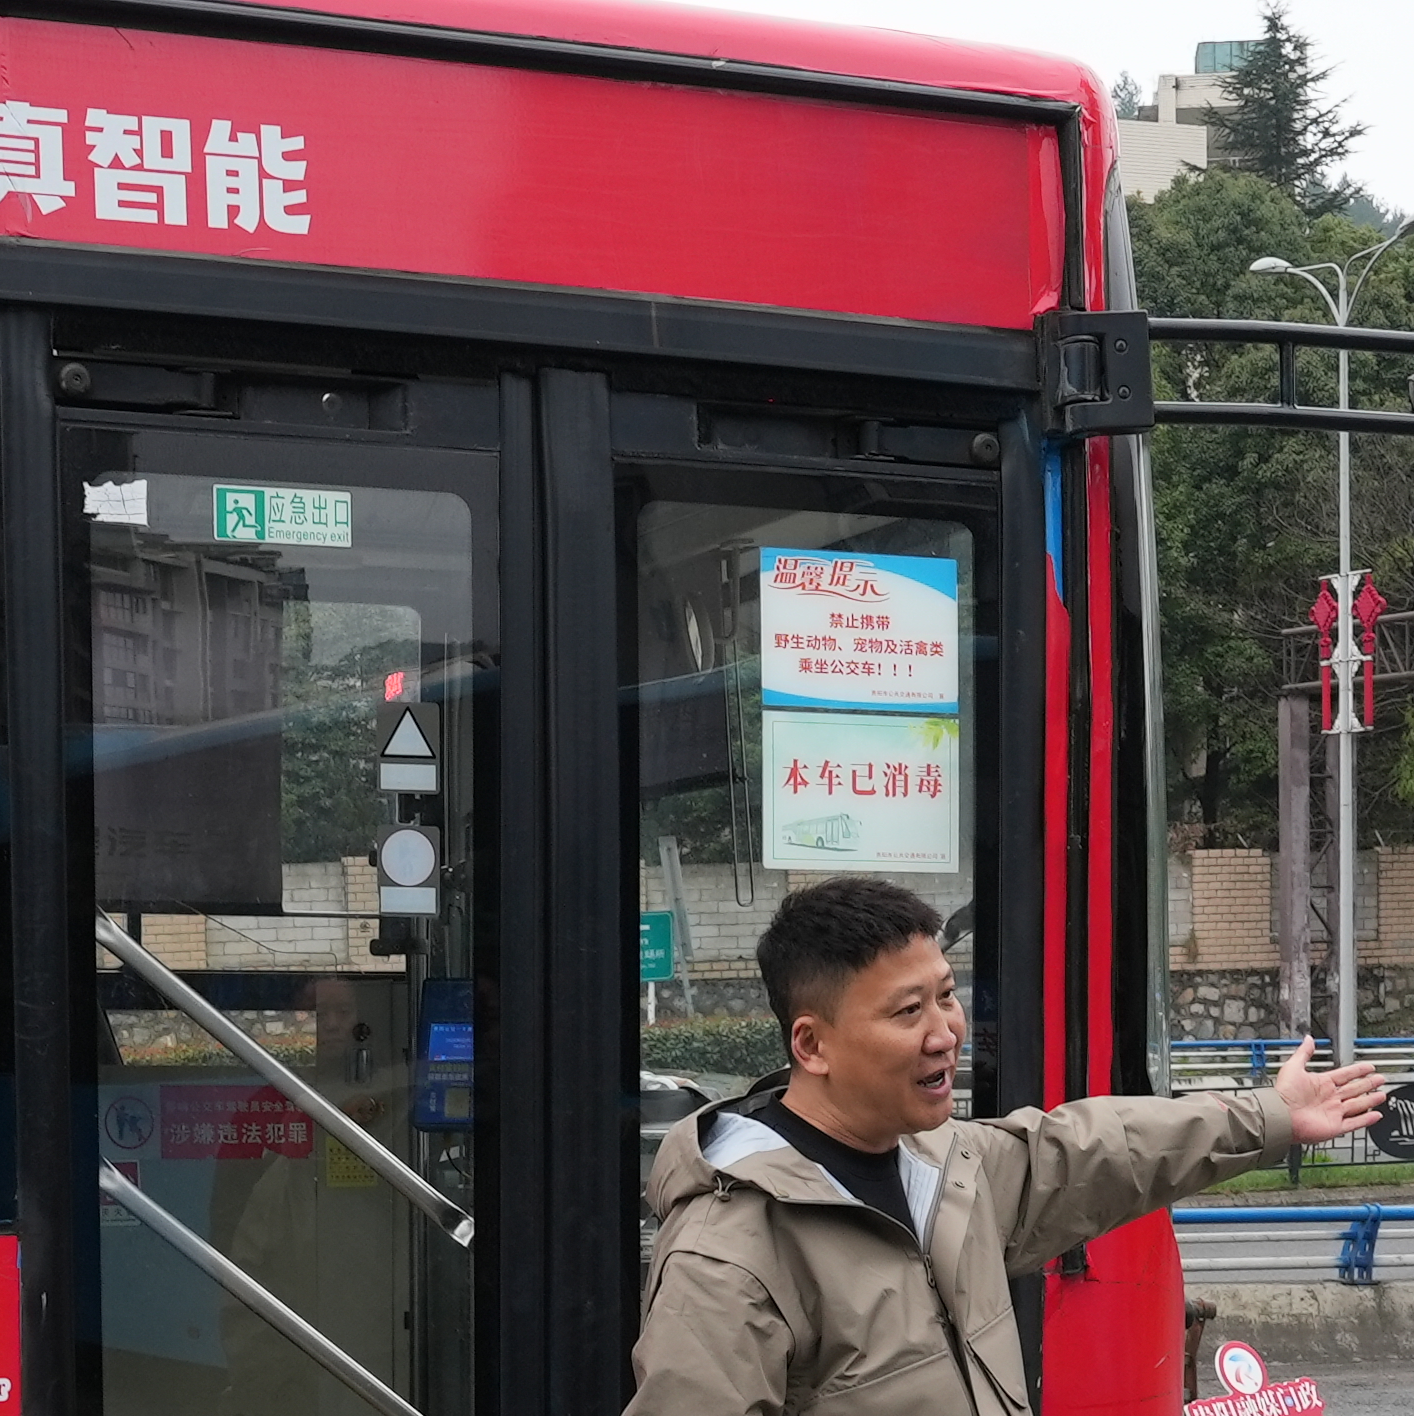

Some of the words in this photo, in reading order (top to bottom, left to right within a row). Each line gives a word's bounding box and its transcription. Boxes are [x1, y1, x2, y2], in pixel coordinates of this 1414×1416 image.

[268, 491, 349, 528] 应急出口
[268, 527, 328, 544] Emergency
[330, 531, 350, 544] exit
[771, 556, 890, 600] 温馨提示
[829, 612, 891, 631] 禁止携带
[774, 633, 944, 657] 野生动物、宠物及活禽类
[782, 758, 943, 799] 本车已消毒
[170, 1122, 308, 1144] 涉嫌违法犯罪
